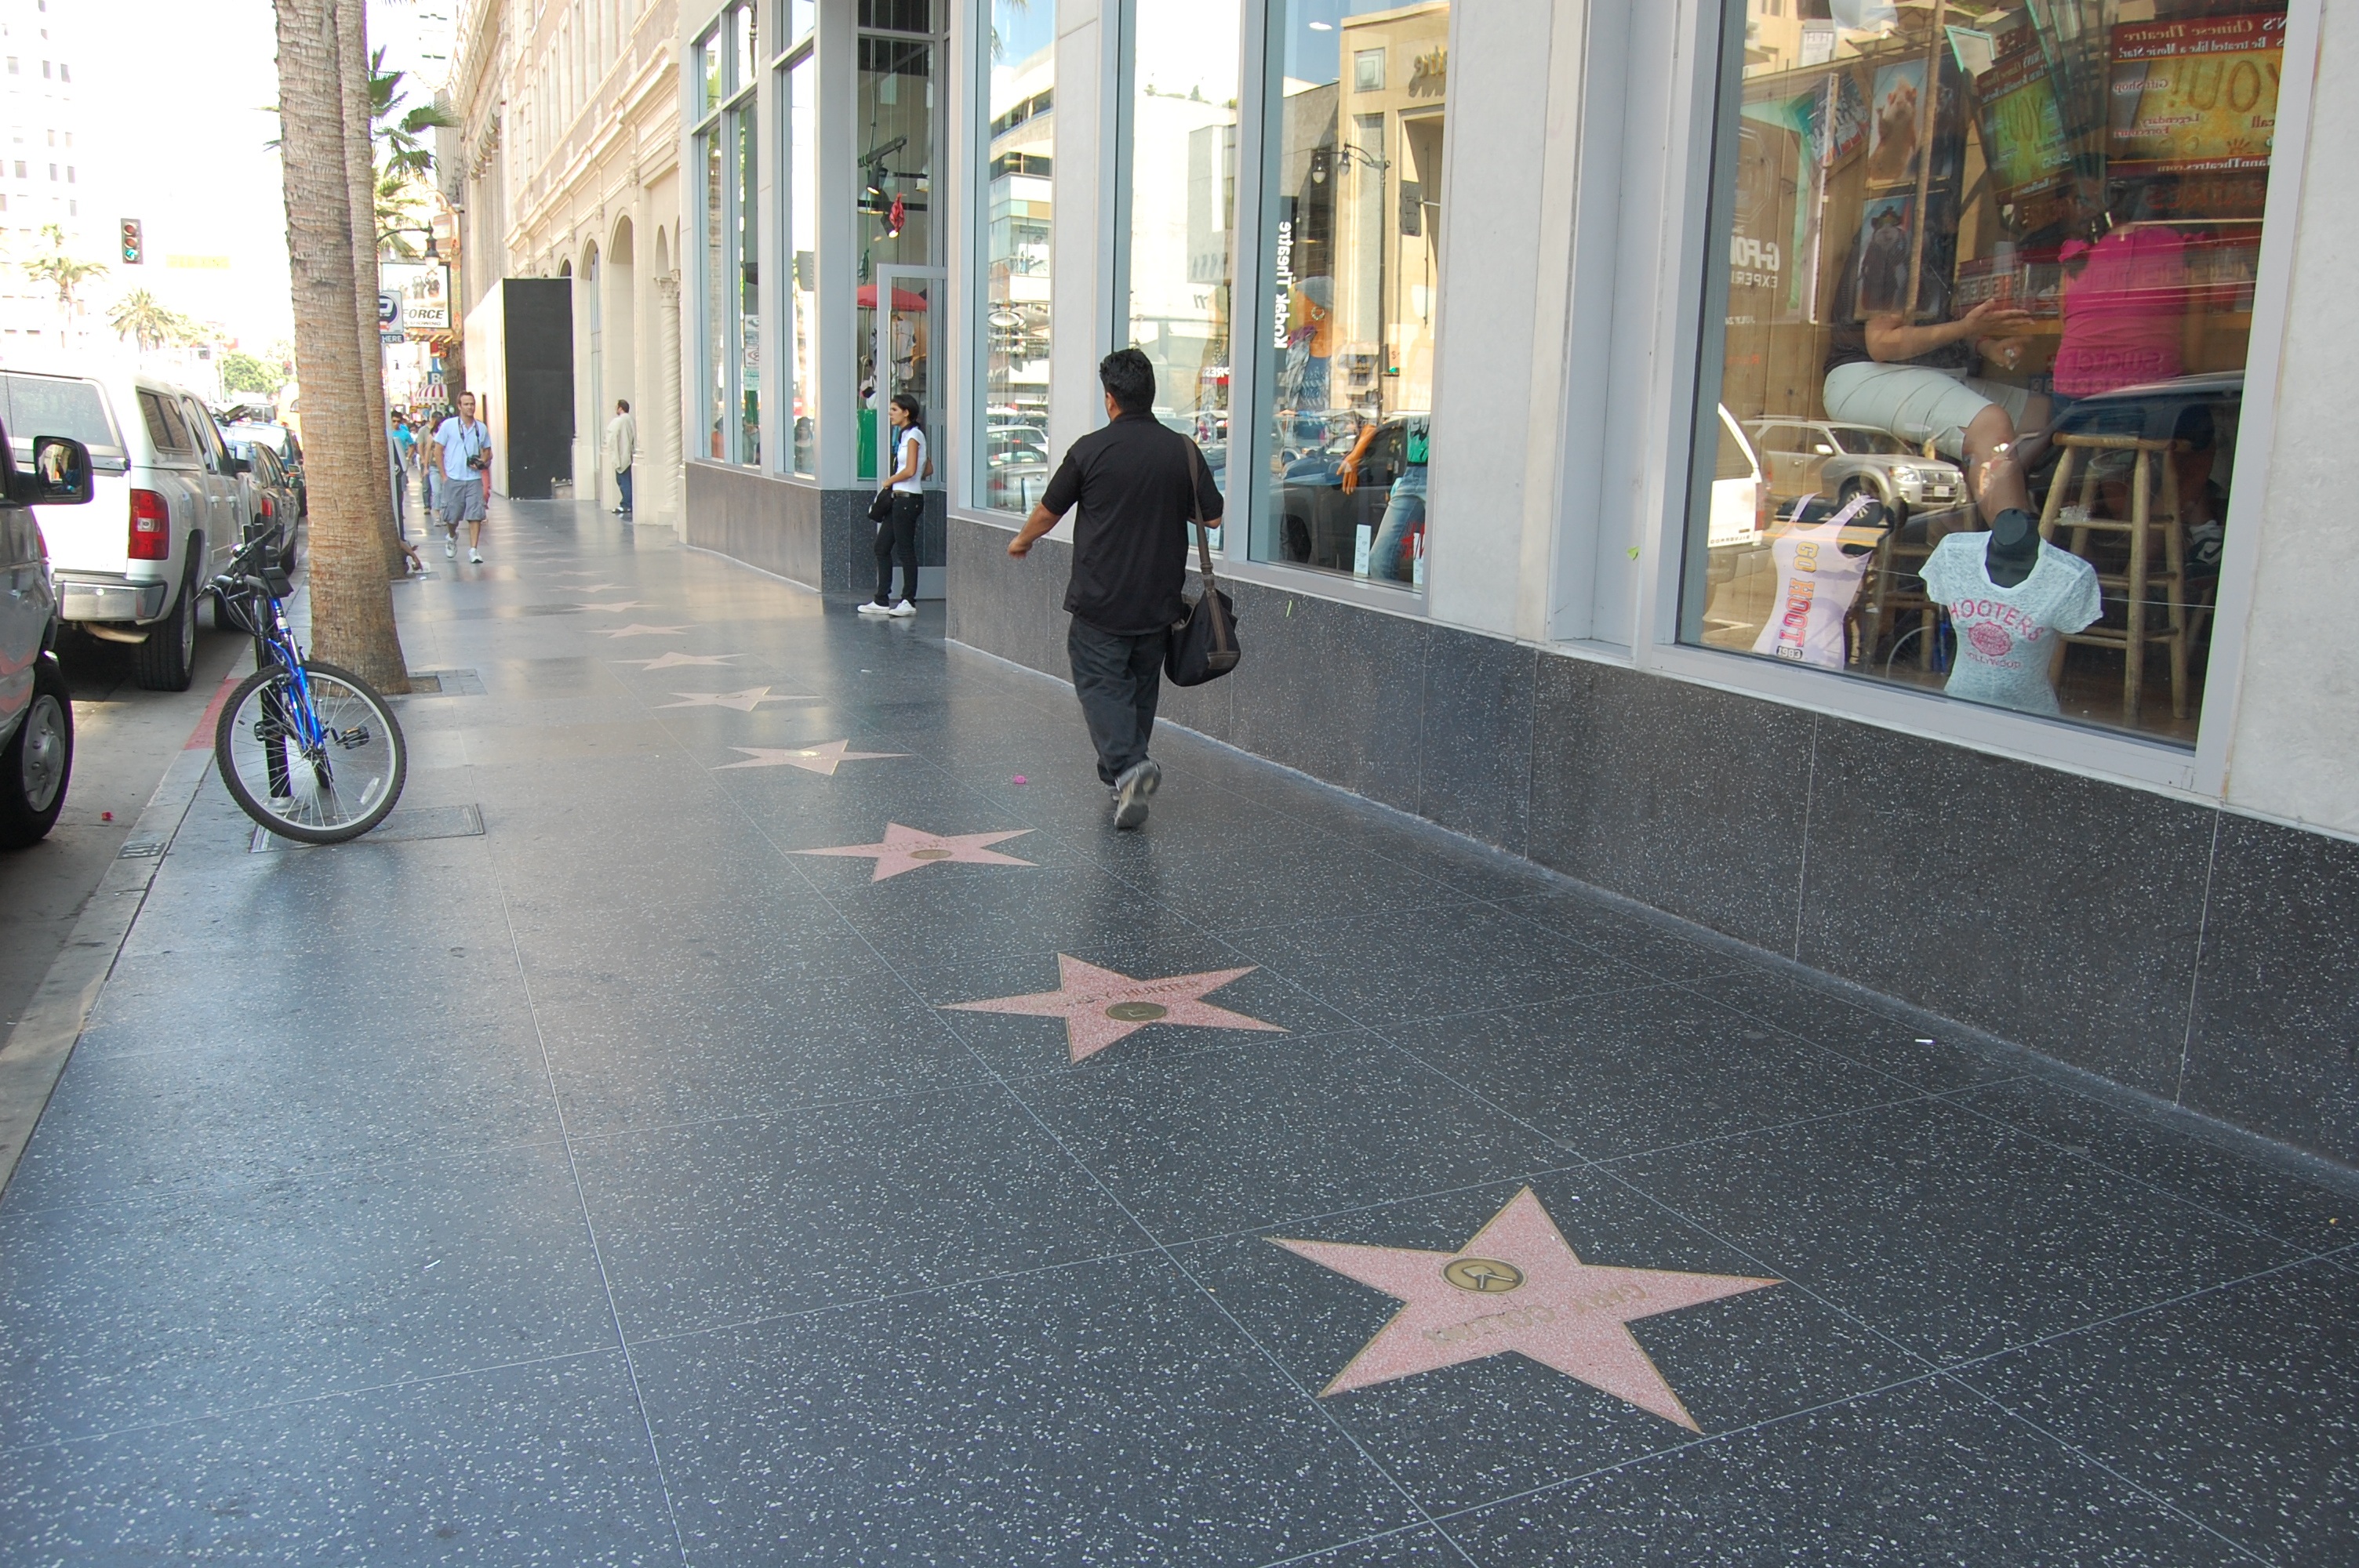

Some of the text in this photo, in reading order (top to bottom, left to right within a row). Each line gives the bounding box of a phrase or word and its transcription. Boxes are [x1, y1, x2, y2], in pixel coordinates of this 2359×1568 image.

[382, 335, 403, 343] HERE
[1778, 541, 1820, 648] GO HOOT
[1950, 598, 2045, 642] HOOTERS
[1777, 645, 1803, 659] 1983
